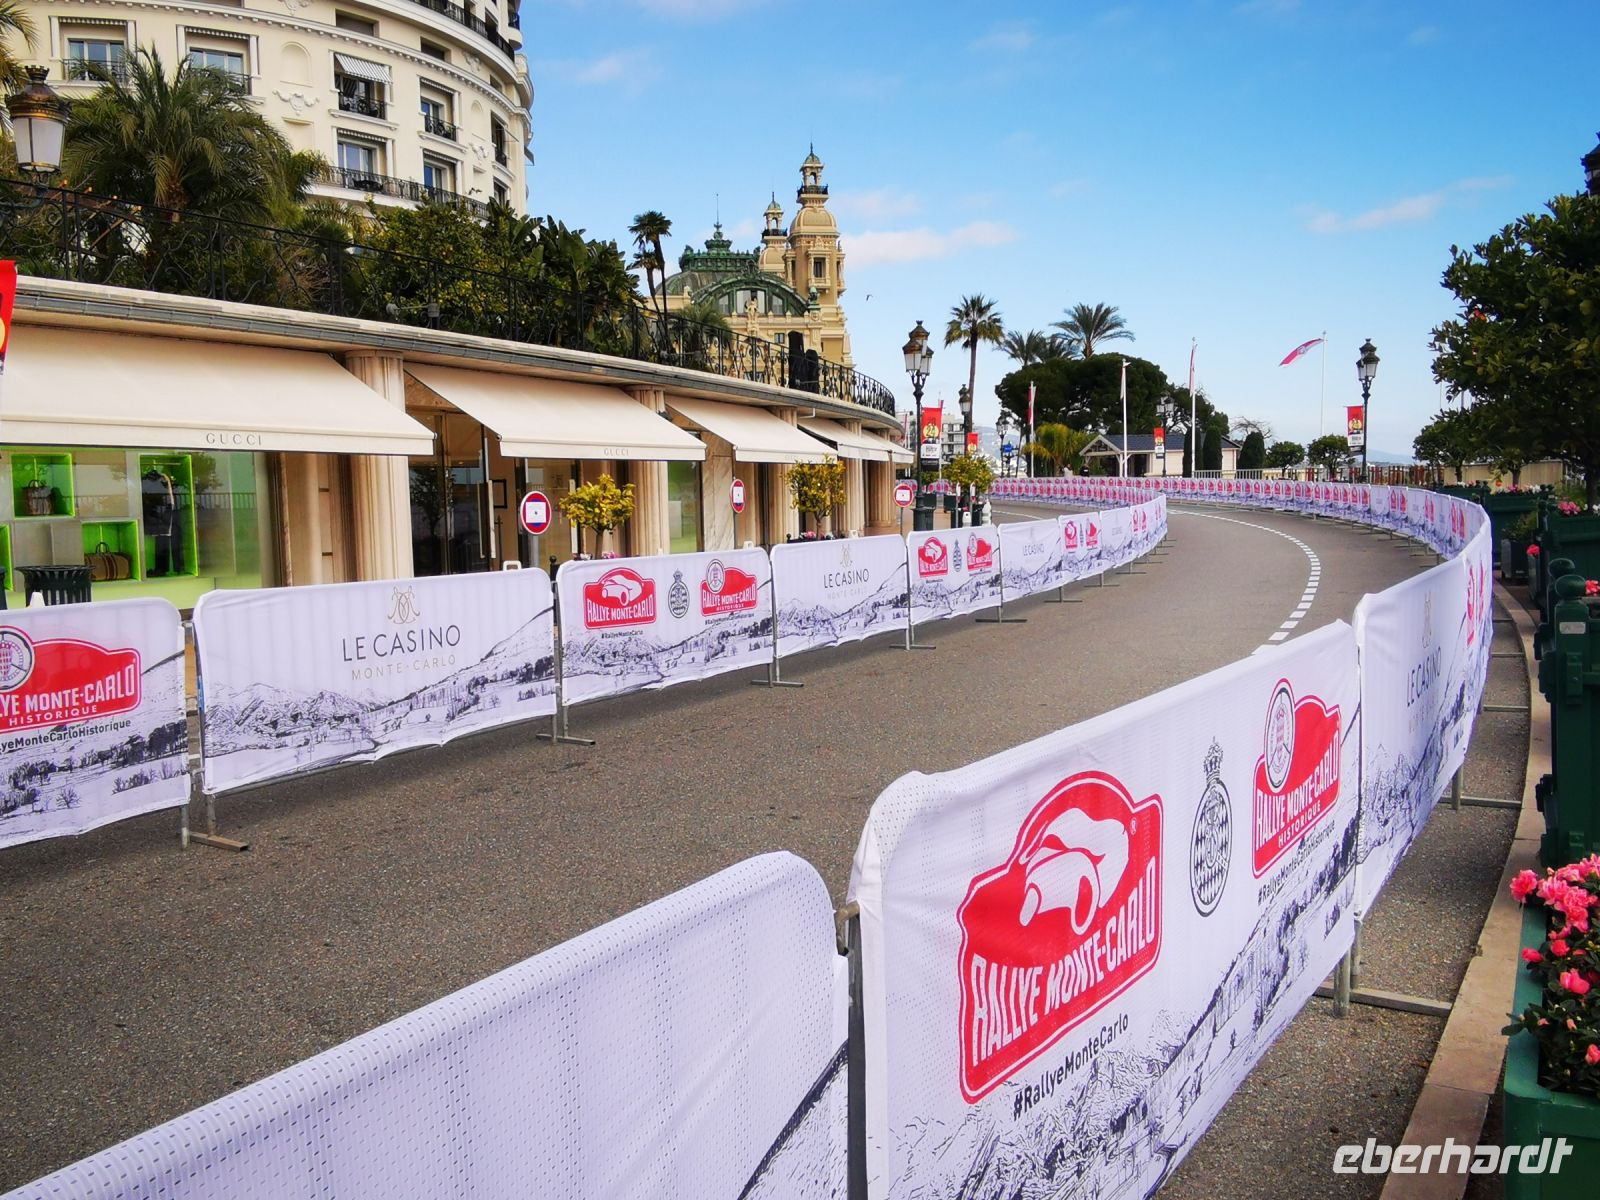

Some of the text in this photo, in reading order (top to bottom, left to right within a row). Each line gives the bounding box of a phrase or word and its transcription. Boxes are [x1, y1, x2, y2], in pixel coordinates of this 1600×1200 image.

[206, 432, 261, 446] GUCCI
[586, 594, 654, 622] RALLYE MONTE-CARLO
[703, 589, 721, 608] RALLYE
[25, 664, 135, 713] MONTE-CARLO
[9, 705, 98, 726] HISTORIQUE
[1256, 729, 1338, 850] RALLYE MONTE-CARLO
[1278, 801, 1321, 848] HISTORIQUE
[970, 856, 1156, 1067] RALLYE MONTE-CARLO
[1013, 1013, 1129, 1121] #RallyeMonteCarlo
